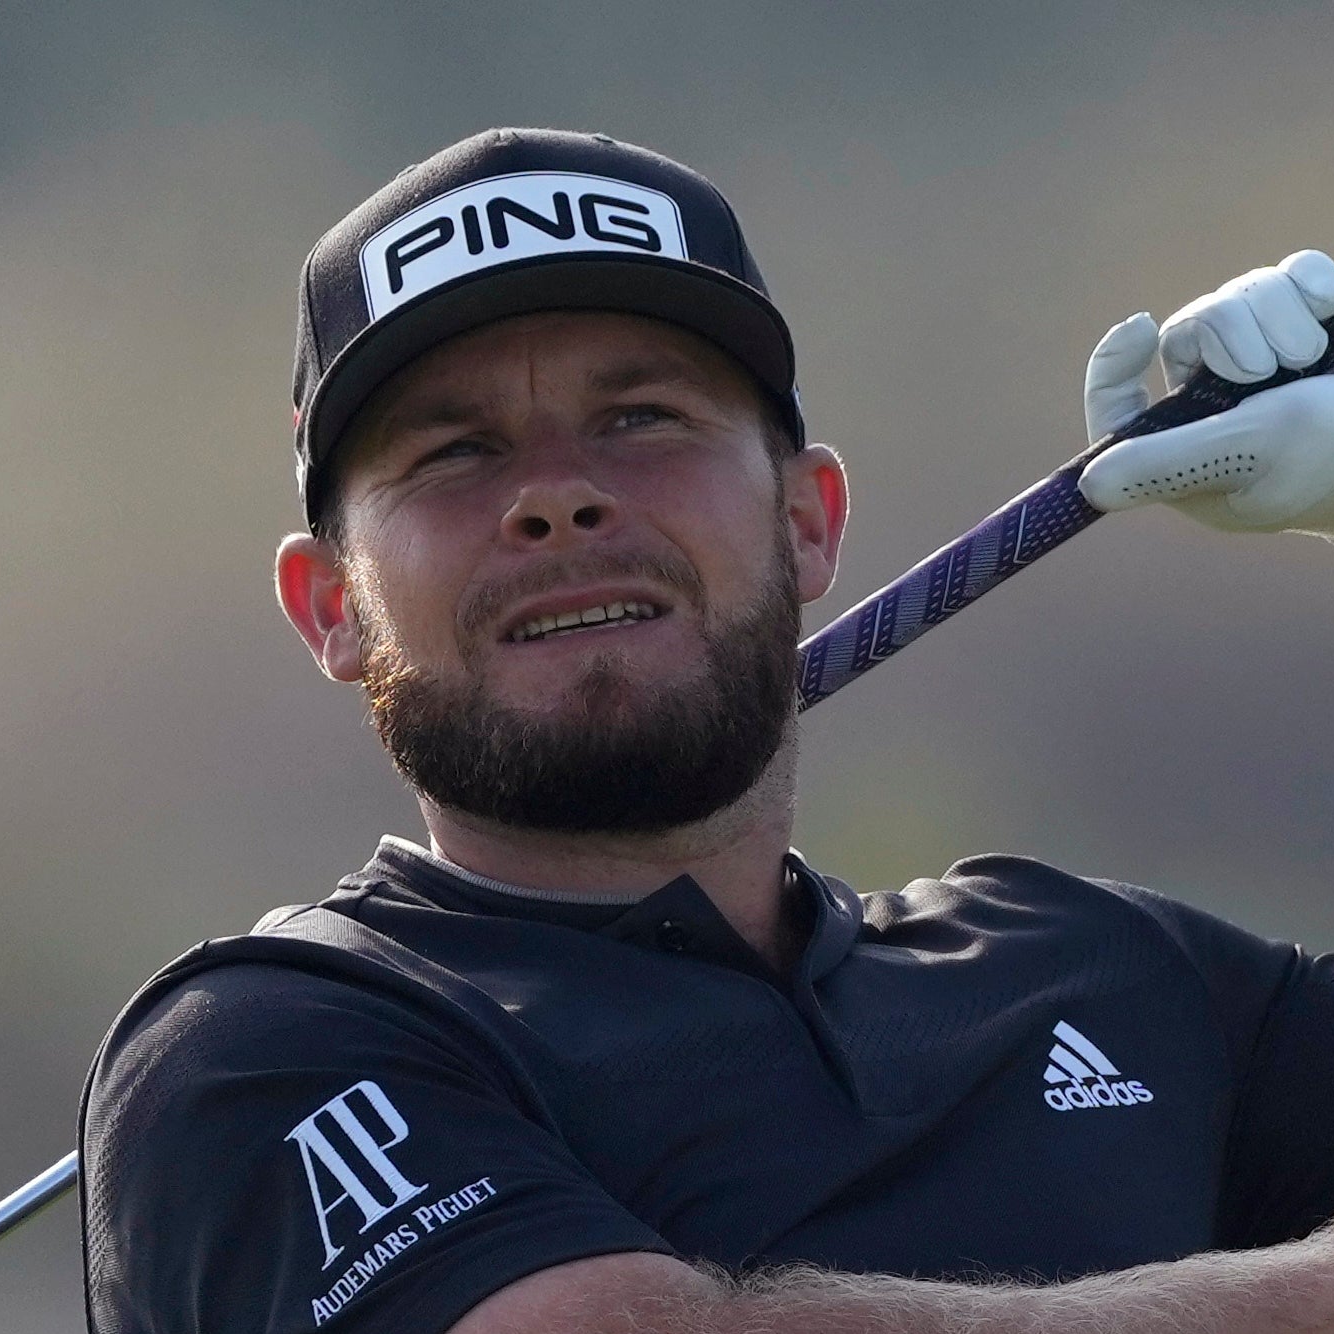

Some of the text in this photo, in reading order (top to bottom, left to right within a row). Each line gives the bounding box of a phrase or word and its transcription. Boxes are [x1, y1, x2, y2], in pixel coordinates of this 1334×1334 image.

[384, 191, 662, 294] PING
[1043, 1075, 1154, 1111] adidas
[283, 1080, 429, 1271] AP
[310, 1176, 498, 1327] AUDEMARS PIGUET
